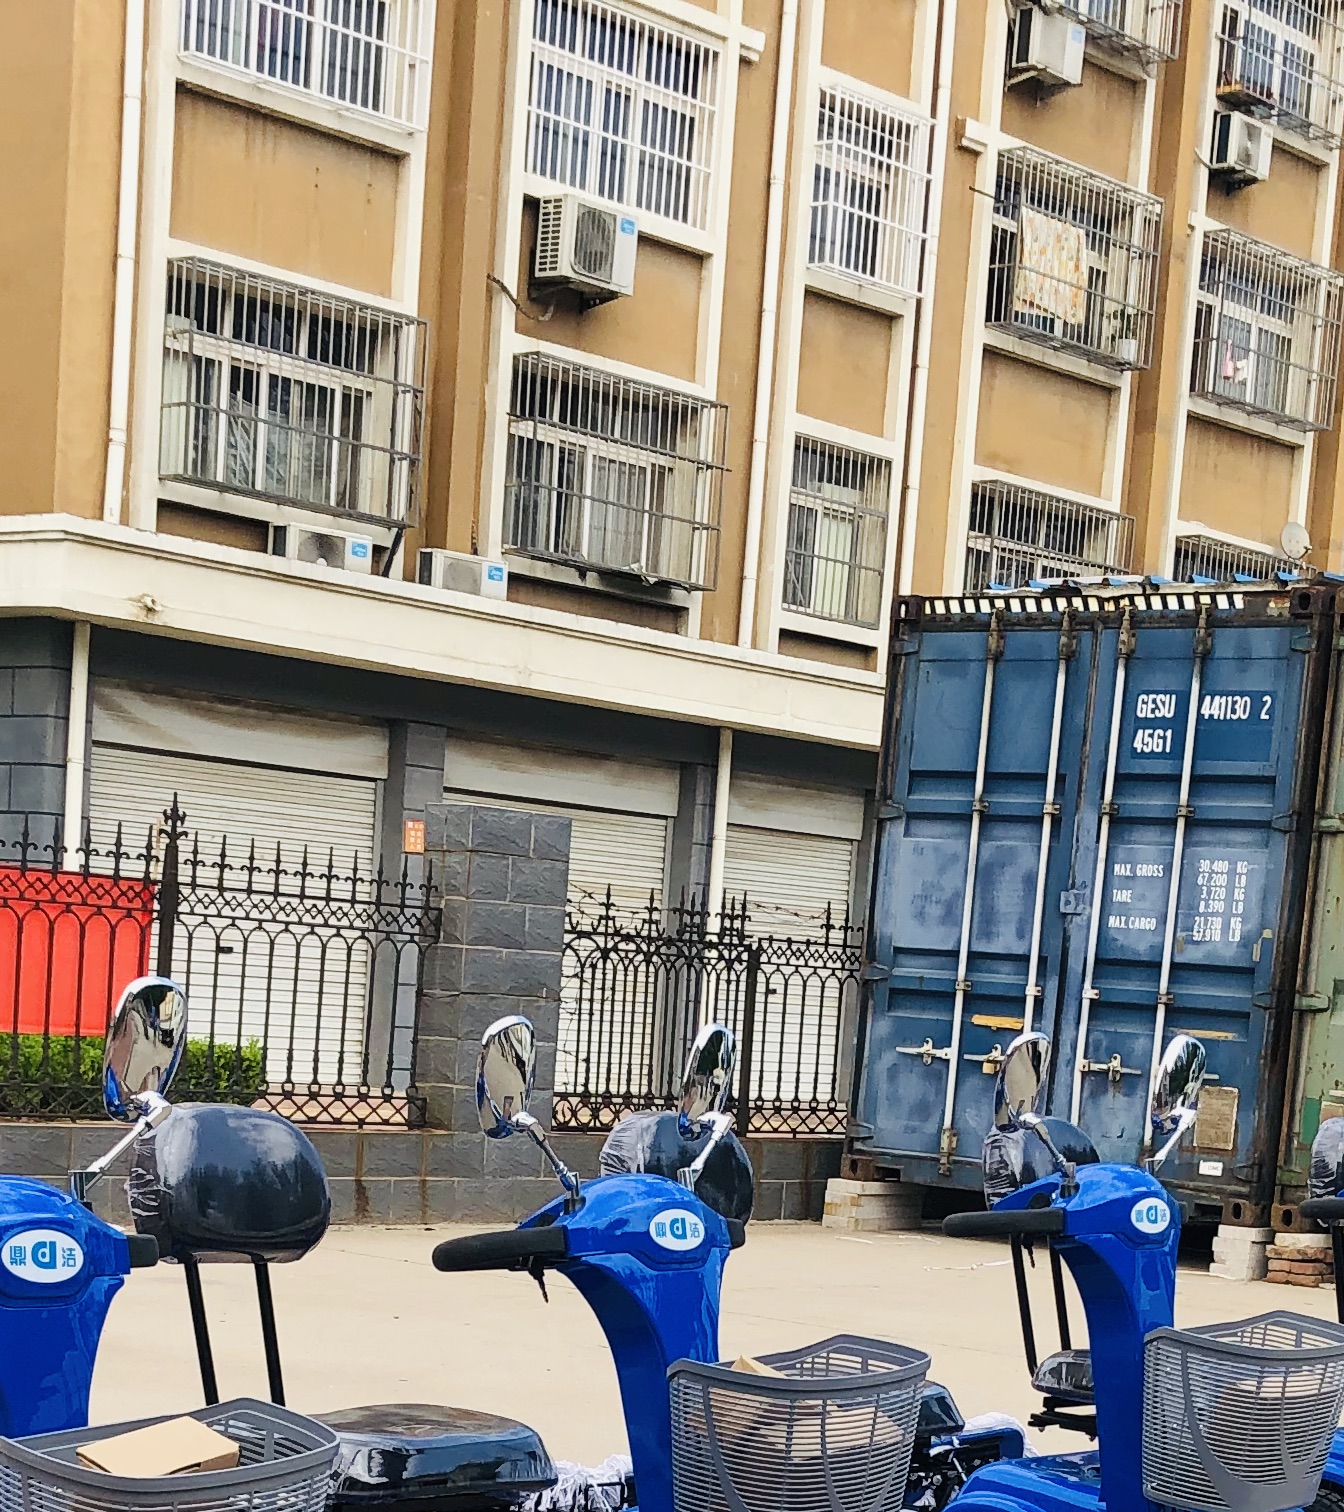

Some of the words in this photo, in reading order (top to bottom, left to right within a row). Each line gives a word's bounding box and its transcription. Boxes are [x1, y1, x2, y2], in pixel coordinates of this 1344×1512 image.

[1136, 694, 1176, 718] GESU
[1201, 695, 1251, 720] 441130
[1260, 695, 1272, 720] 2
[1133, 729, 1172, 753] 45G1
[1136, 864, 1164, 877] GROSS
[1199, 860, 1229, 873] 30.480
[1237, 861, 1248, 873] KG
[1197, 874, 1227, 886] 67.200
[1235, 875, 1247, 887] LB
[1112, 889, 1133, 903] TARE
[1201, 886, 1226, 899] 3.720
[1233, 888, 1245, 900] KG
[1199, 901, 1224, 913] 8.390
[1232, 901, 1244, 914] LB
[1230, 917, 1242, 930] KG
[1229, 929, 1241, 942] LB
[62, 1247, 76, 1267] 洁
